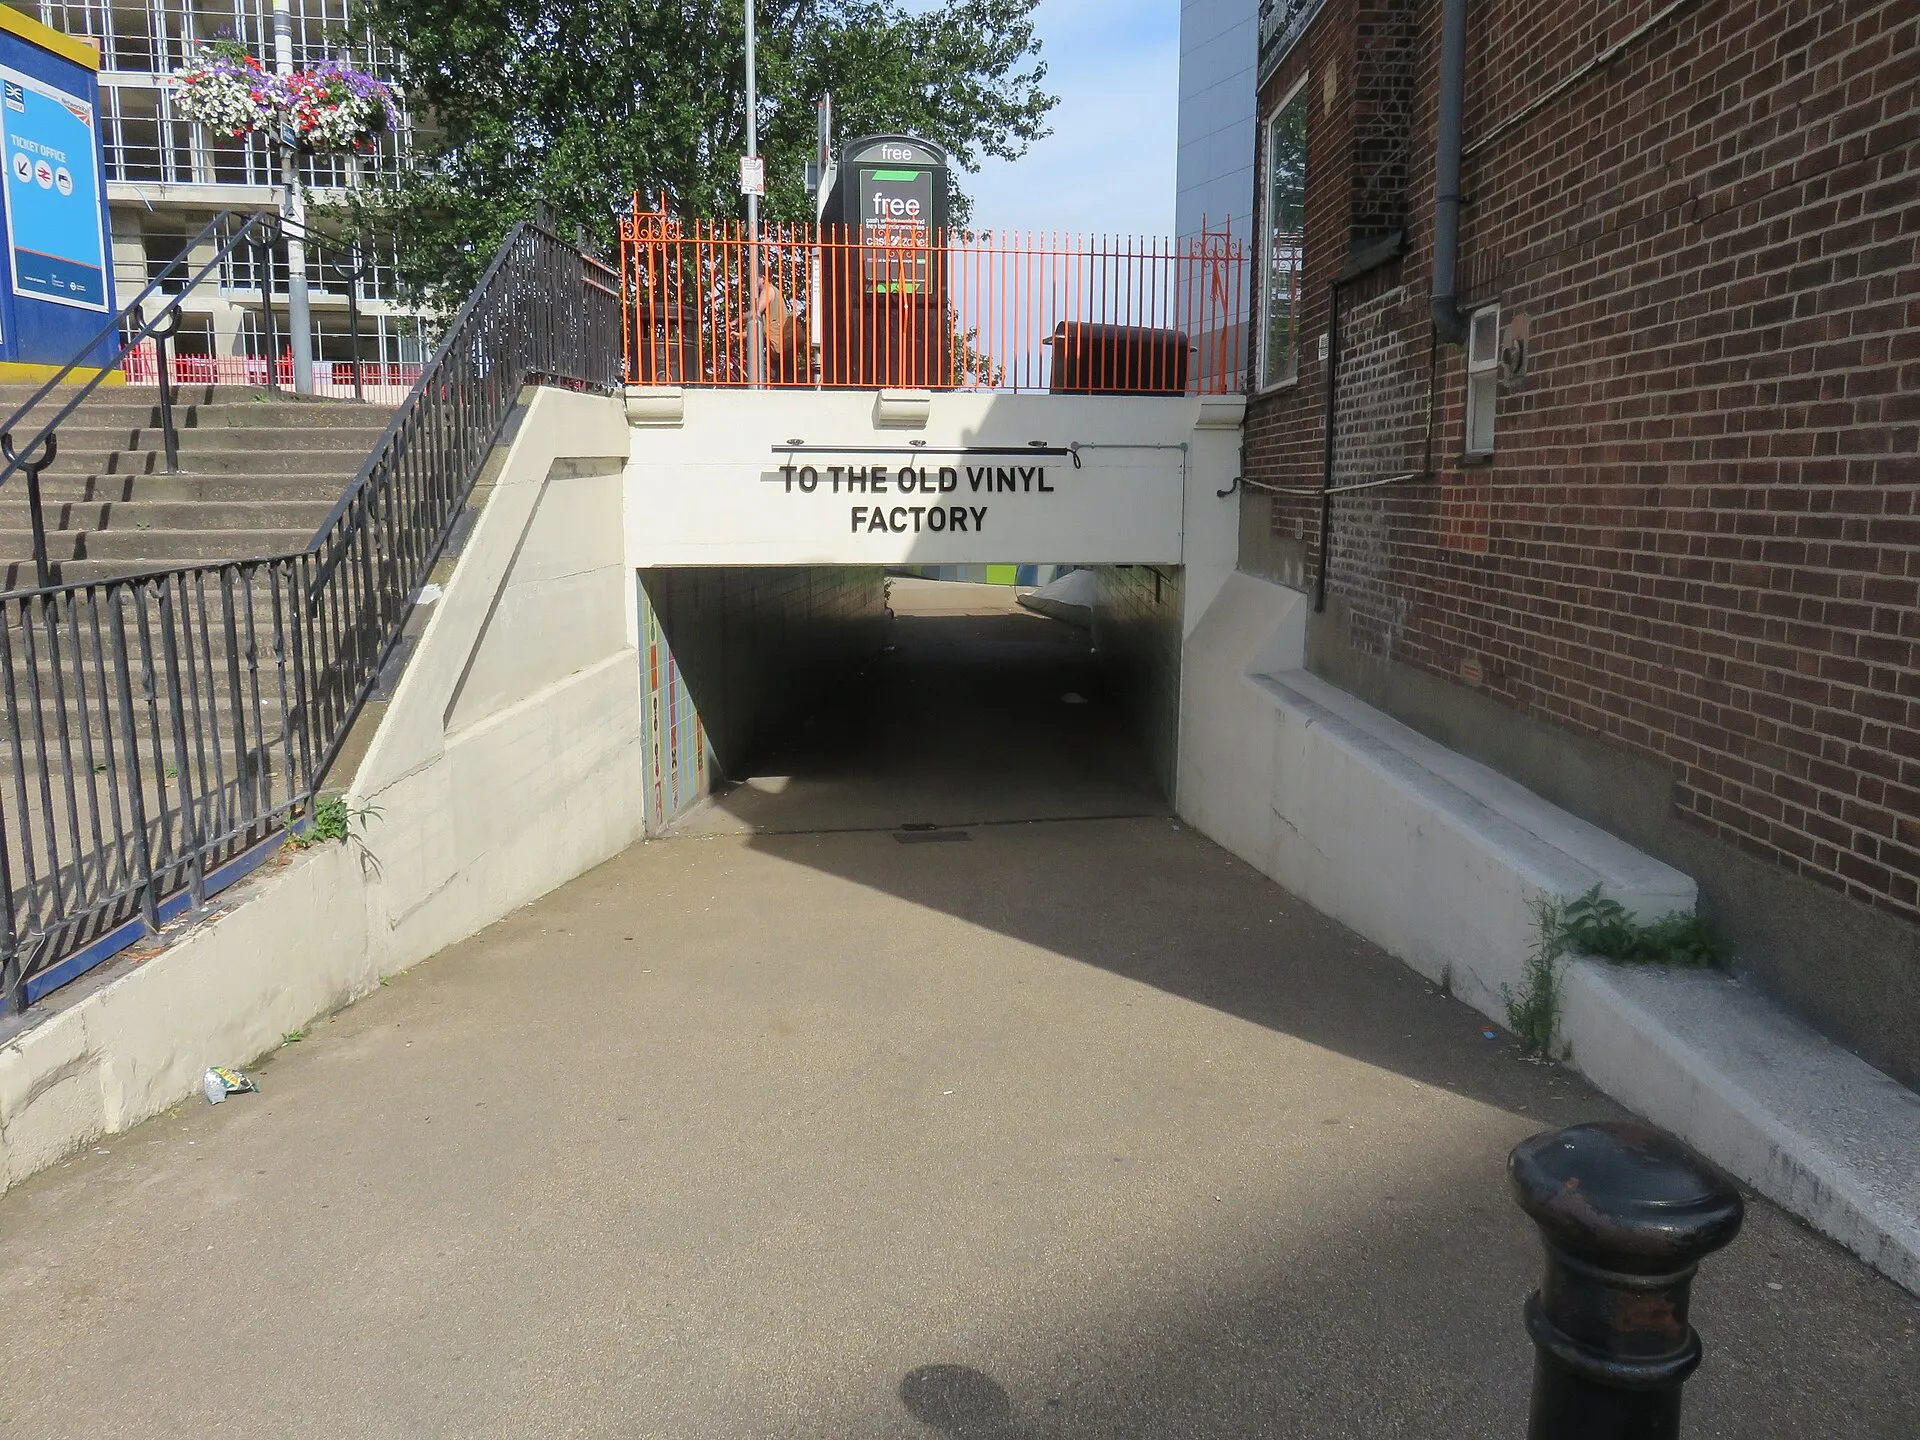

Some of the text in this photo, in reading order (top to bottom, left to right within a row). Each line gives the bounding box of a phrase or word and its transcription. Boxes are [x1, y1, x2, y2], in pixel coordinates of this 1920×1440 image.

[10, 133, 67, 163] TICKET OFFICE
[881, 145, 912, 161] free
[873, 193, 920, 216] free
[780, 466, 1054, 492] TO THE OLD VINYL
[851, 506, 988, 533] FACTORY
